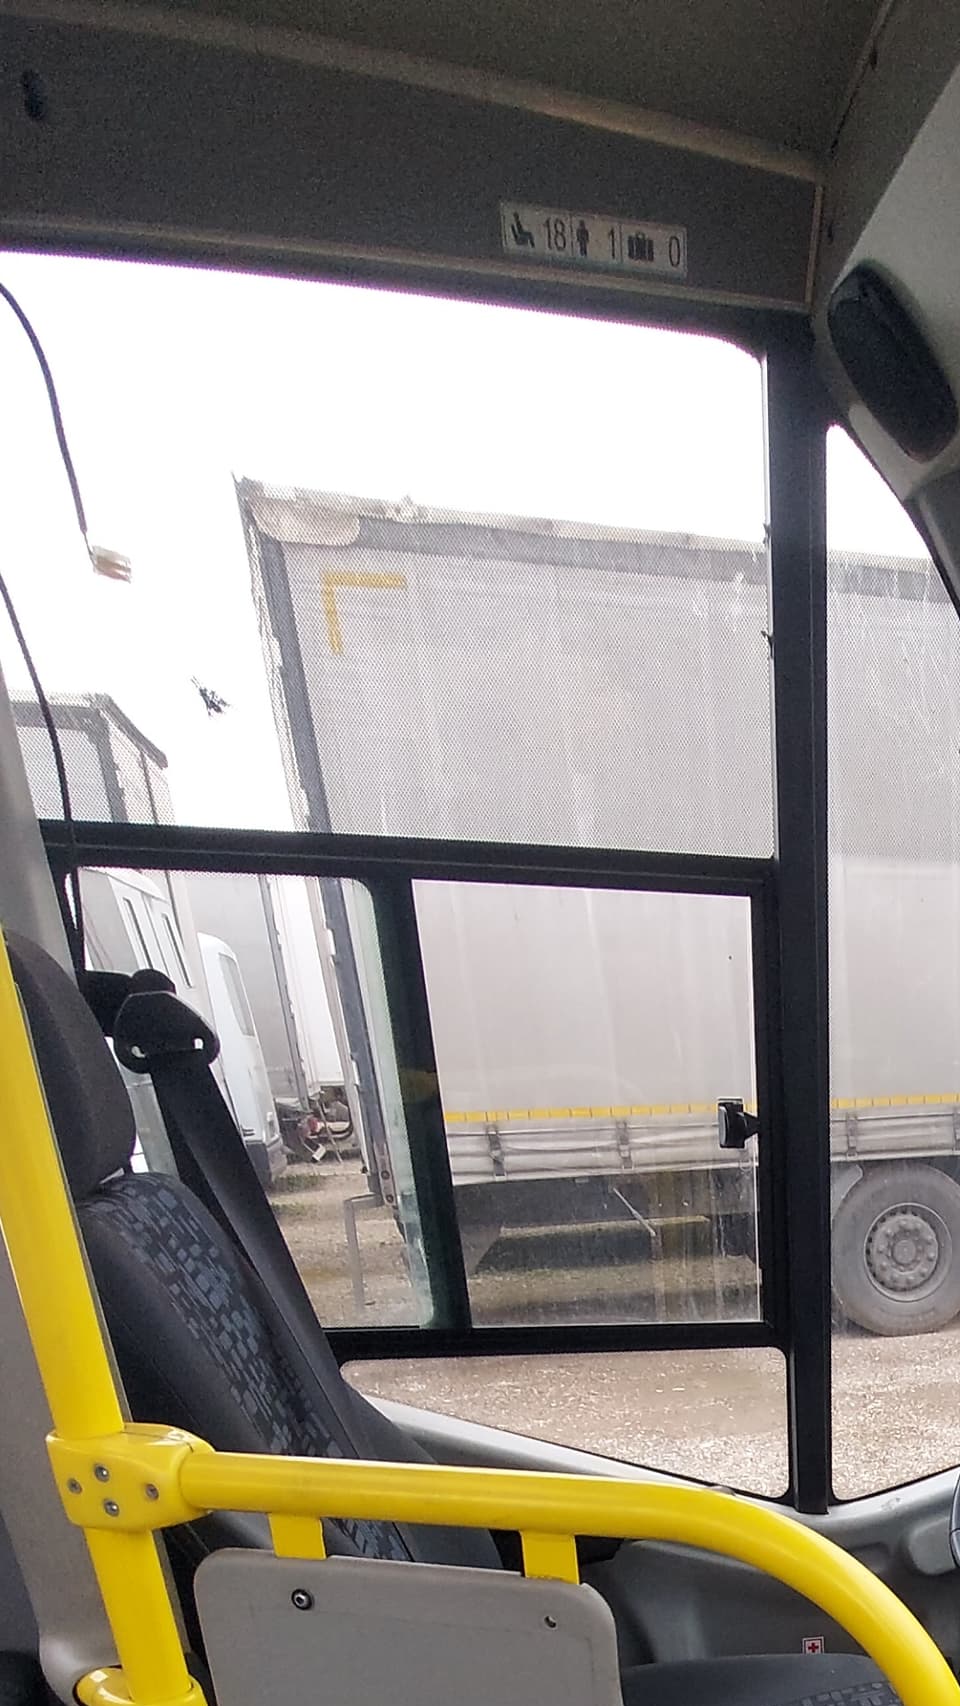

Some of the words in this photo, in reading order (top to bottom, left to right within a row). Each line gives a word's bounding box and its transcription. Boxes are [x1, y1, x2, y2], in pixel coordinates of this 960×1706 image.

[543, 217, 566, 250] 18
[607, 228, 616, 259] 1
[668, 235, 681, 267] 0
